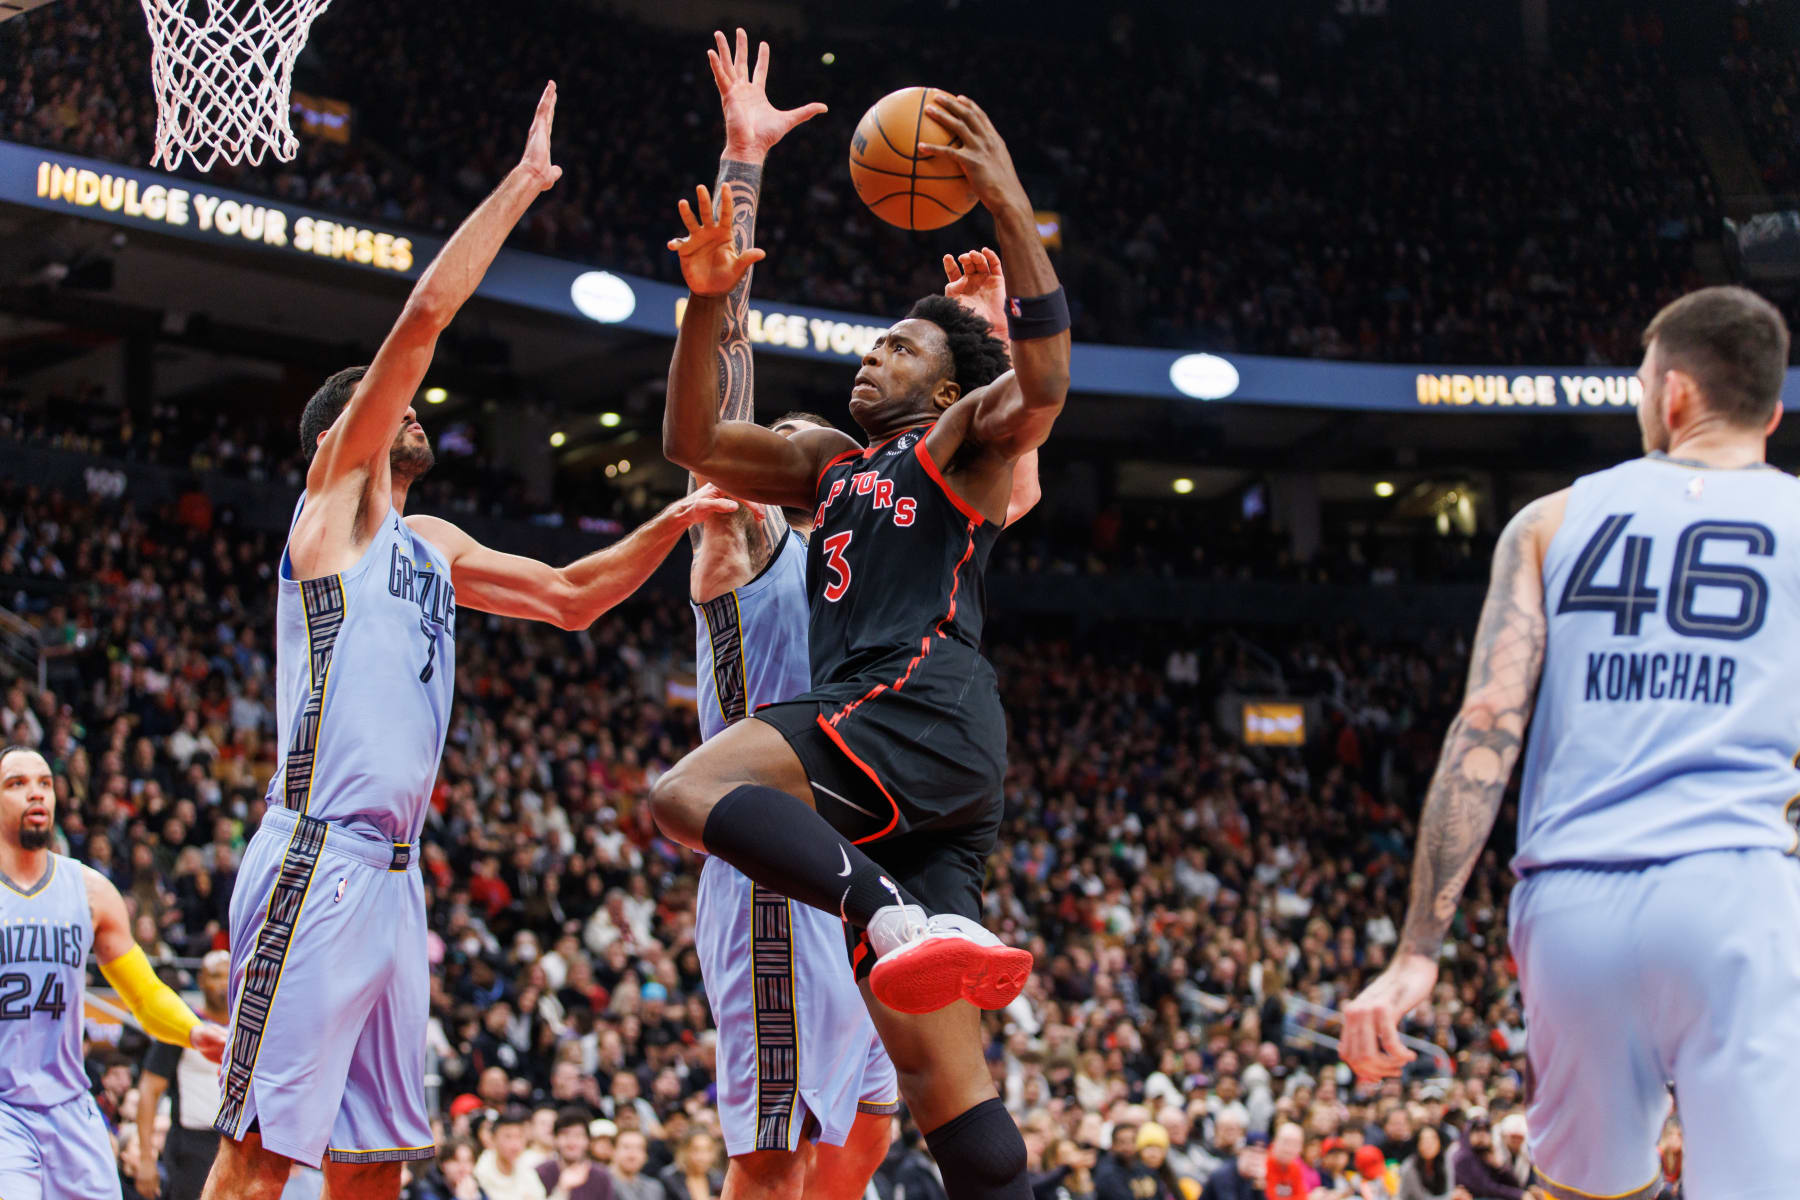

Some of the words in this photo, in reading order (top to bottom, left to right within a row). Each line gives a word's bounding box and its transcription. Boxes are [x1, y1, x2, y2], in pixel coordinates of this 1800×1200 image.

[37, 161, 190, 226] INDULGE
[193, 193, 288, 248] YOUR
[294, 216, 414, 272] SENSES
[675, 297, 808, 349] ILGE
[1416, 374, 1556, 406] INDULGE
[810, 470, 917, 533] APTORS
[823, 530, 853, 602] 3
[1556, 513, 1776, 642] 46
[1585, 652, 1737, 706] KONCHAR
[0, 972, 66, 1020] 24
